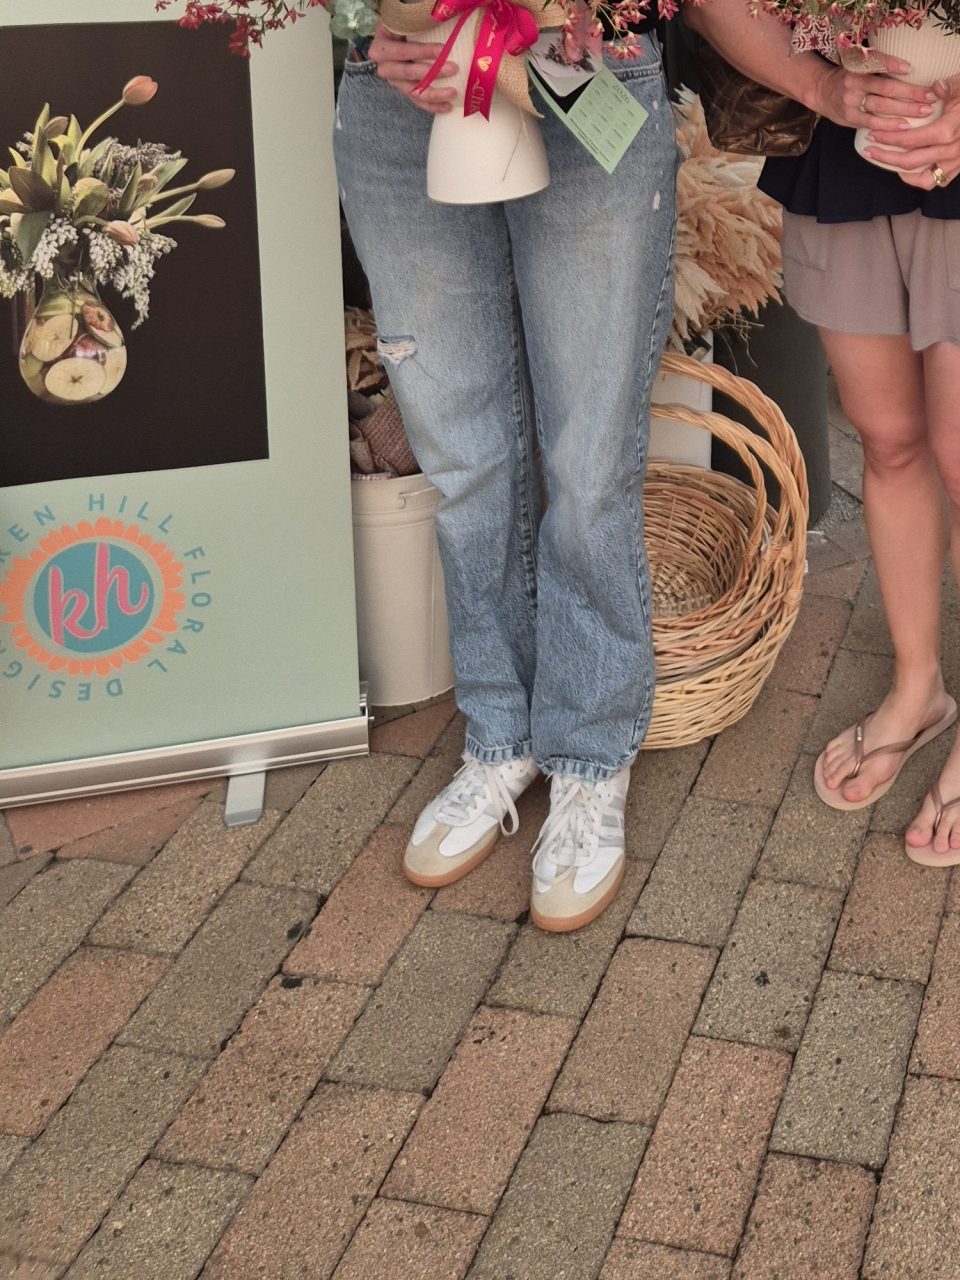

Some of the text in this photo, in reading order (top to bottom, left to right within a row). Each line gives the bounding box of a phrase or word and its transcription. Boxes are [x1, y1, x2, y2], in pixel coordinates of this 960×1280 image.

[49, 542, 149, 647] kh
[89, 493, 173, 534] HILL
[147, 546, 212, 673] FLORAL
